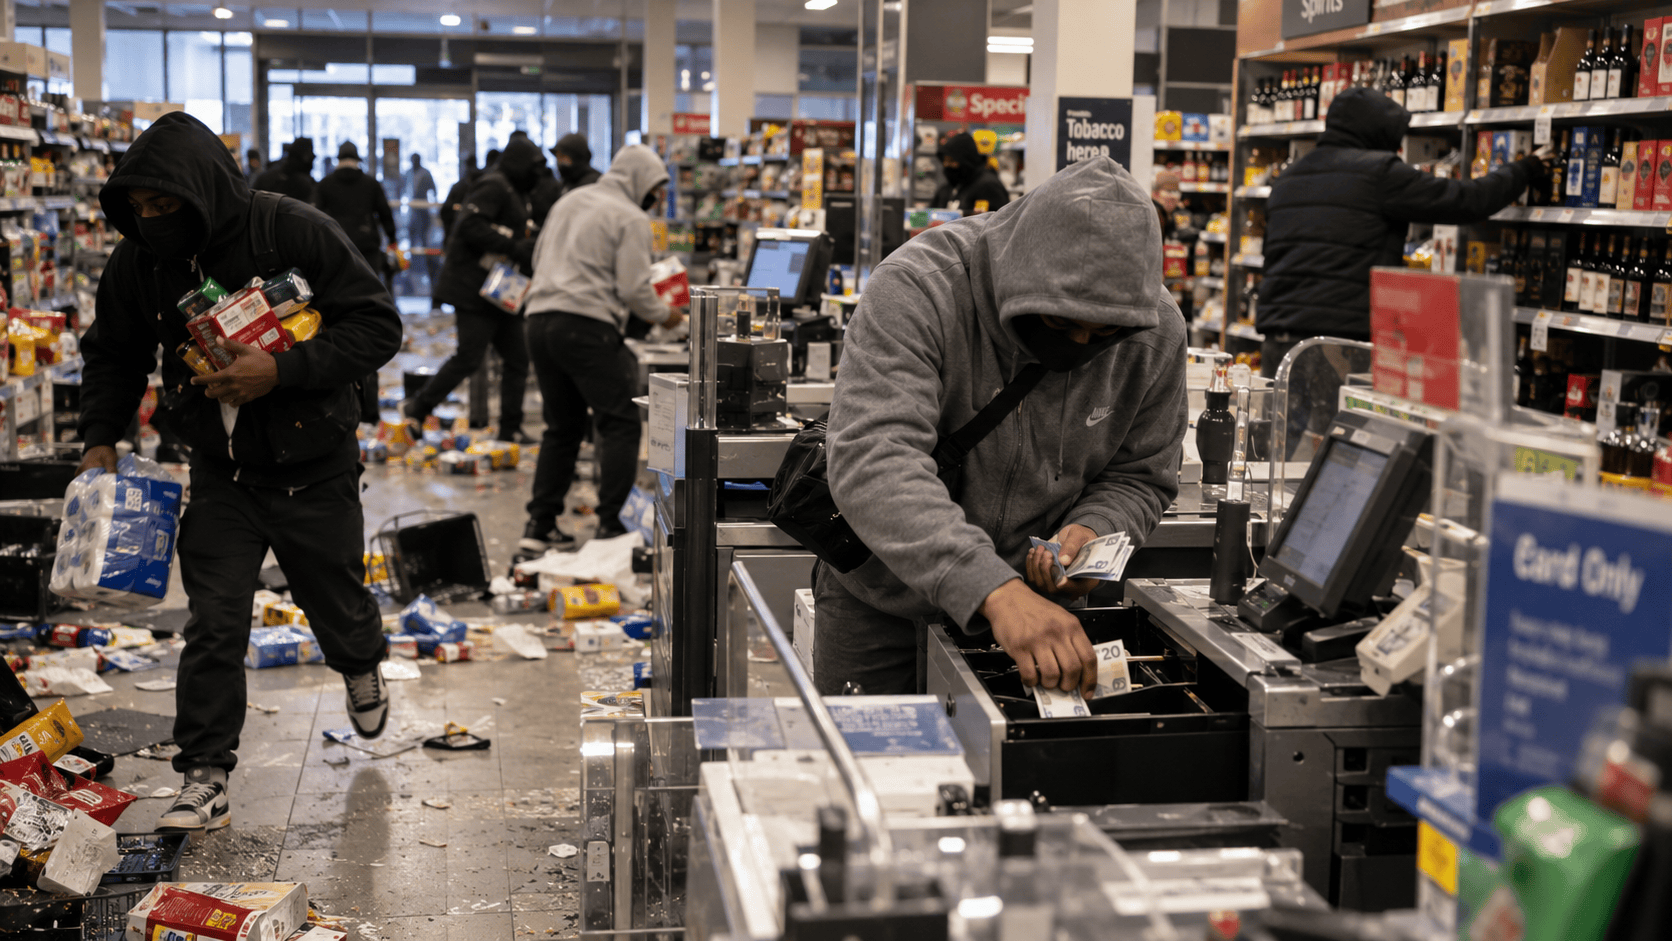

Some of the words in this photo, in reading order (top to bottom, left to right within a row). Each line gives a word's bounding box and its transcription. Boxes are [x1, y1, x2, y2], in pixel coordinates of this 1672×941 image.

[1065, 117, 1125, 140] Tobacco
[1513, 532, 1582, 590] Card
[1581, 546, 1646, 615] Only
[1101, 644, 1121, 661] 20
